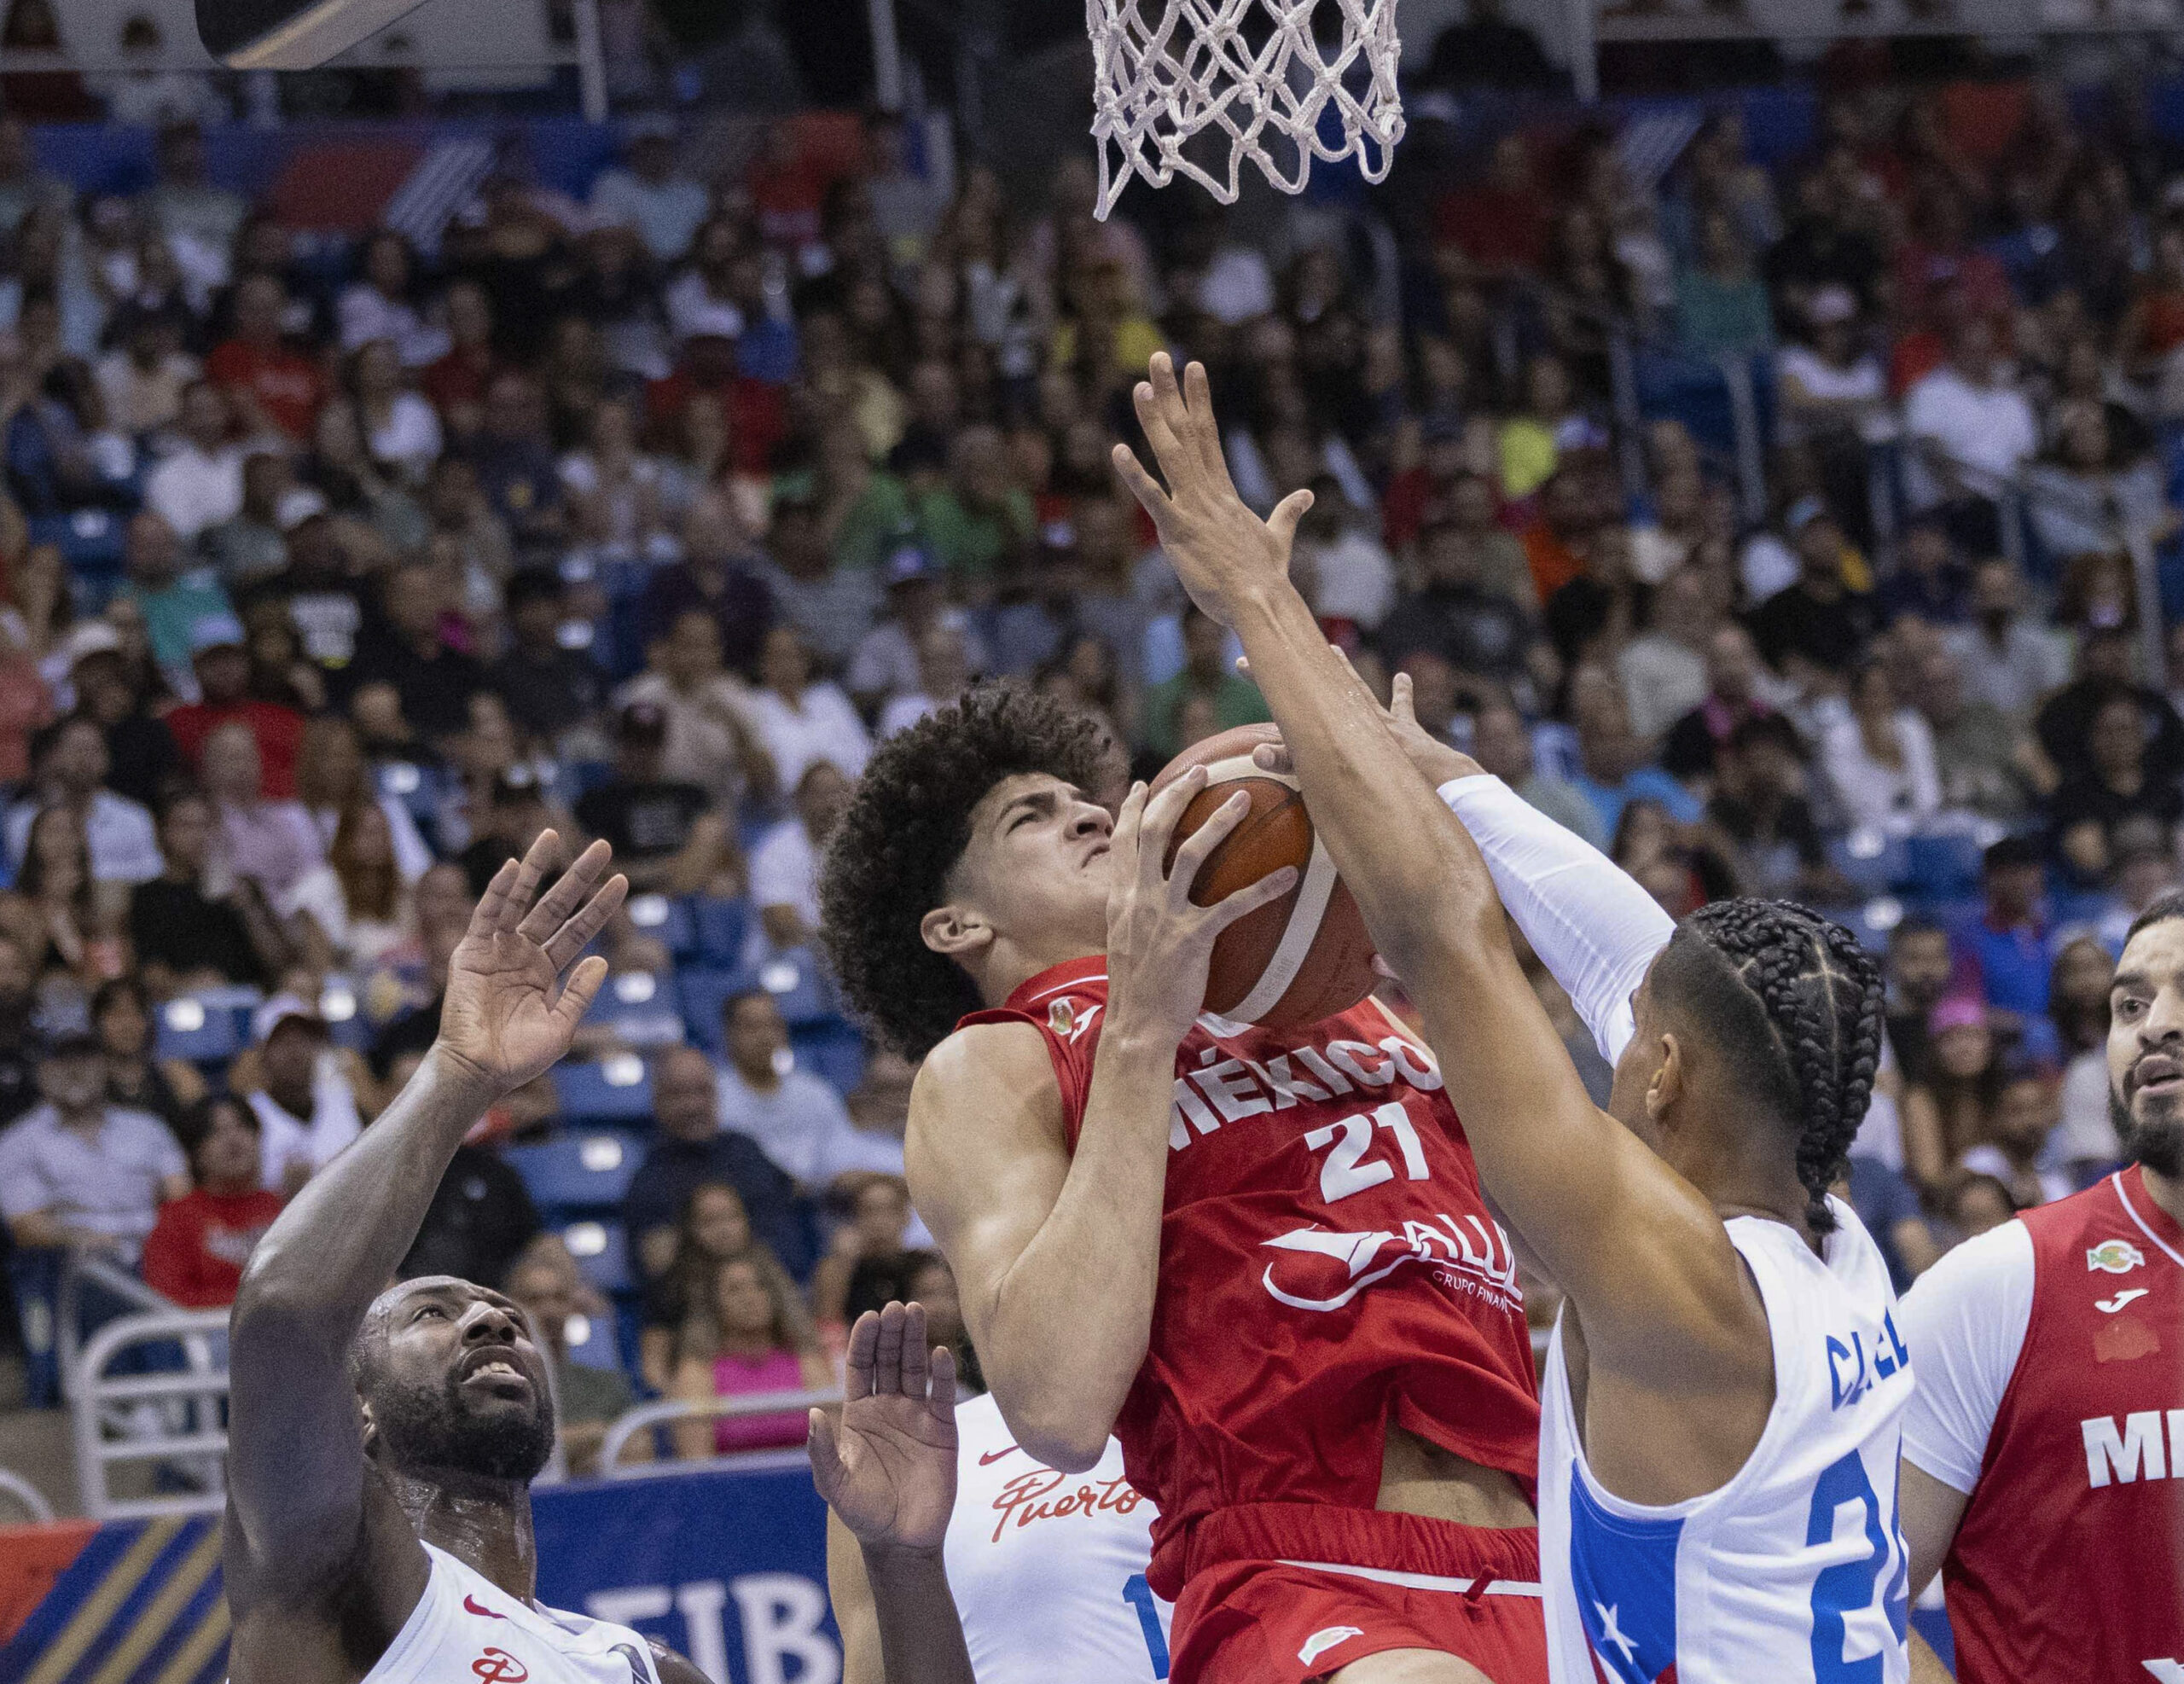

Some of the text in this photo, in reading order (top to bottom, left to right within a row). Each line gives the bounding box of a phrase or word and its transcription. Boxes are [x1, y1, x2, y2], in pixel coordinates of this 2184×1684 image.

[1304, 1101, 1430, 1204] 21
[1432, 1270, 1476, 1295] GRUPO
[991, 1467, 1143, 1543] Puerto
